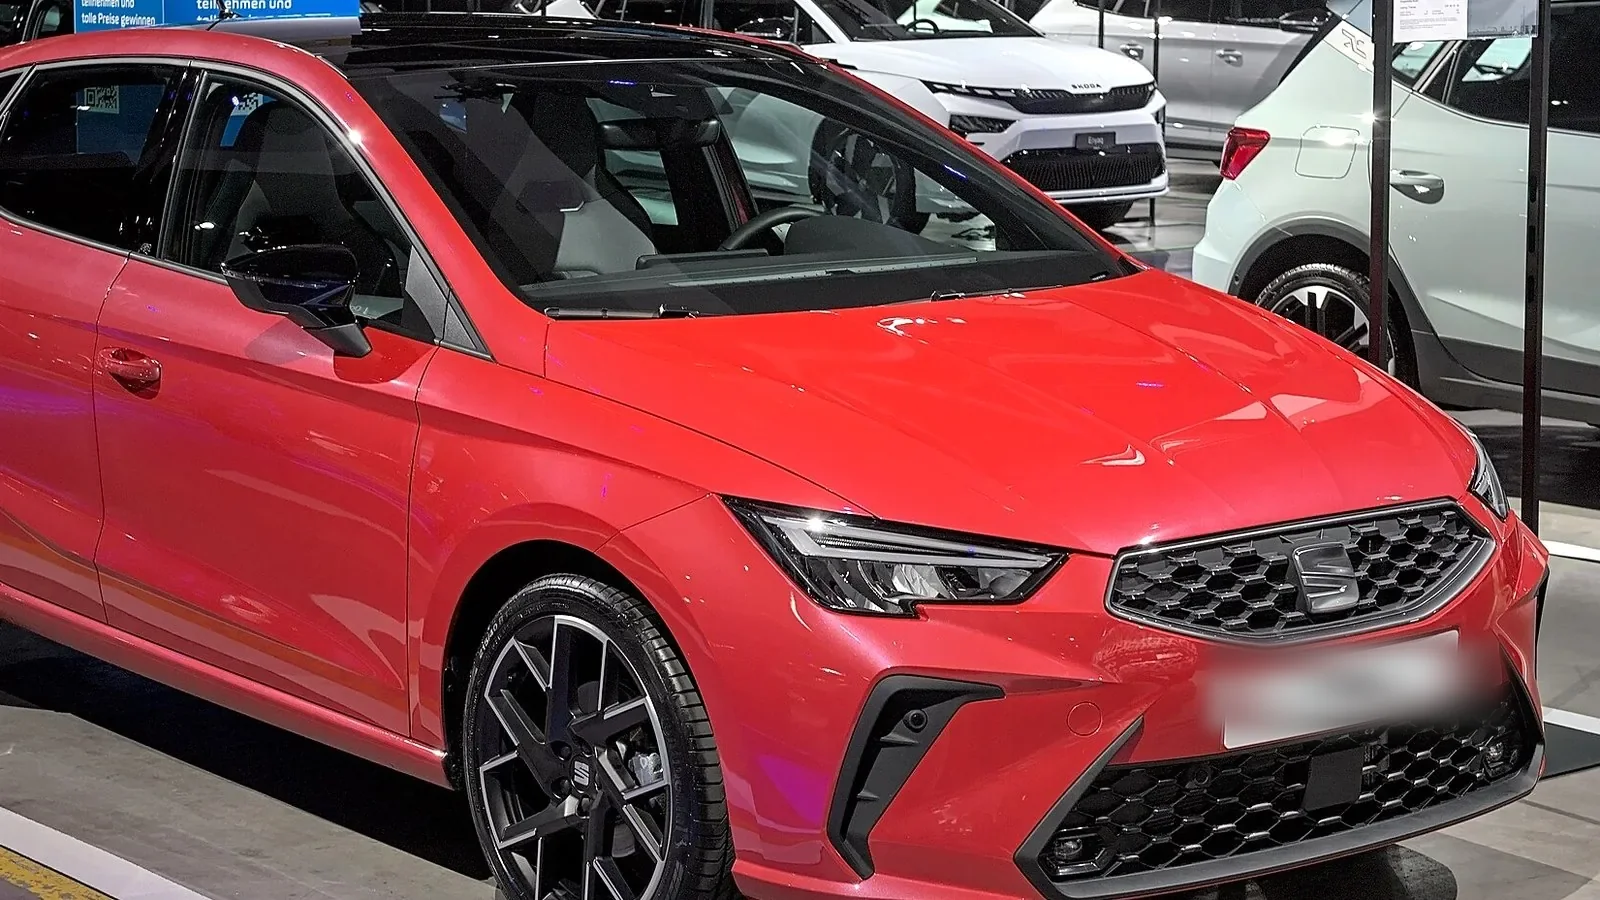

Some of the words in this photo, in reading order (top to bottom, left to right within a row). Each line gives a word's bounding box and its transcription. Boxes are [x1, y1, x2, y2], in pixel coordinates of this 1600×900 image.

[121, 0, 135, 8] und
[196, 0, 266, 9] teilehmen
[269, 0, 292, 9] und
[81, 12, 97, 24] tolle
[98, 12, 119, 25] Preise
[120, 13, 156, 27] gewinnen
